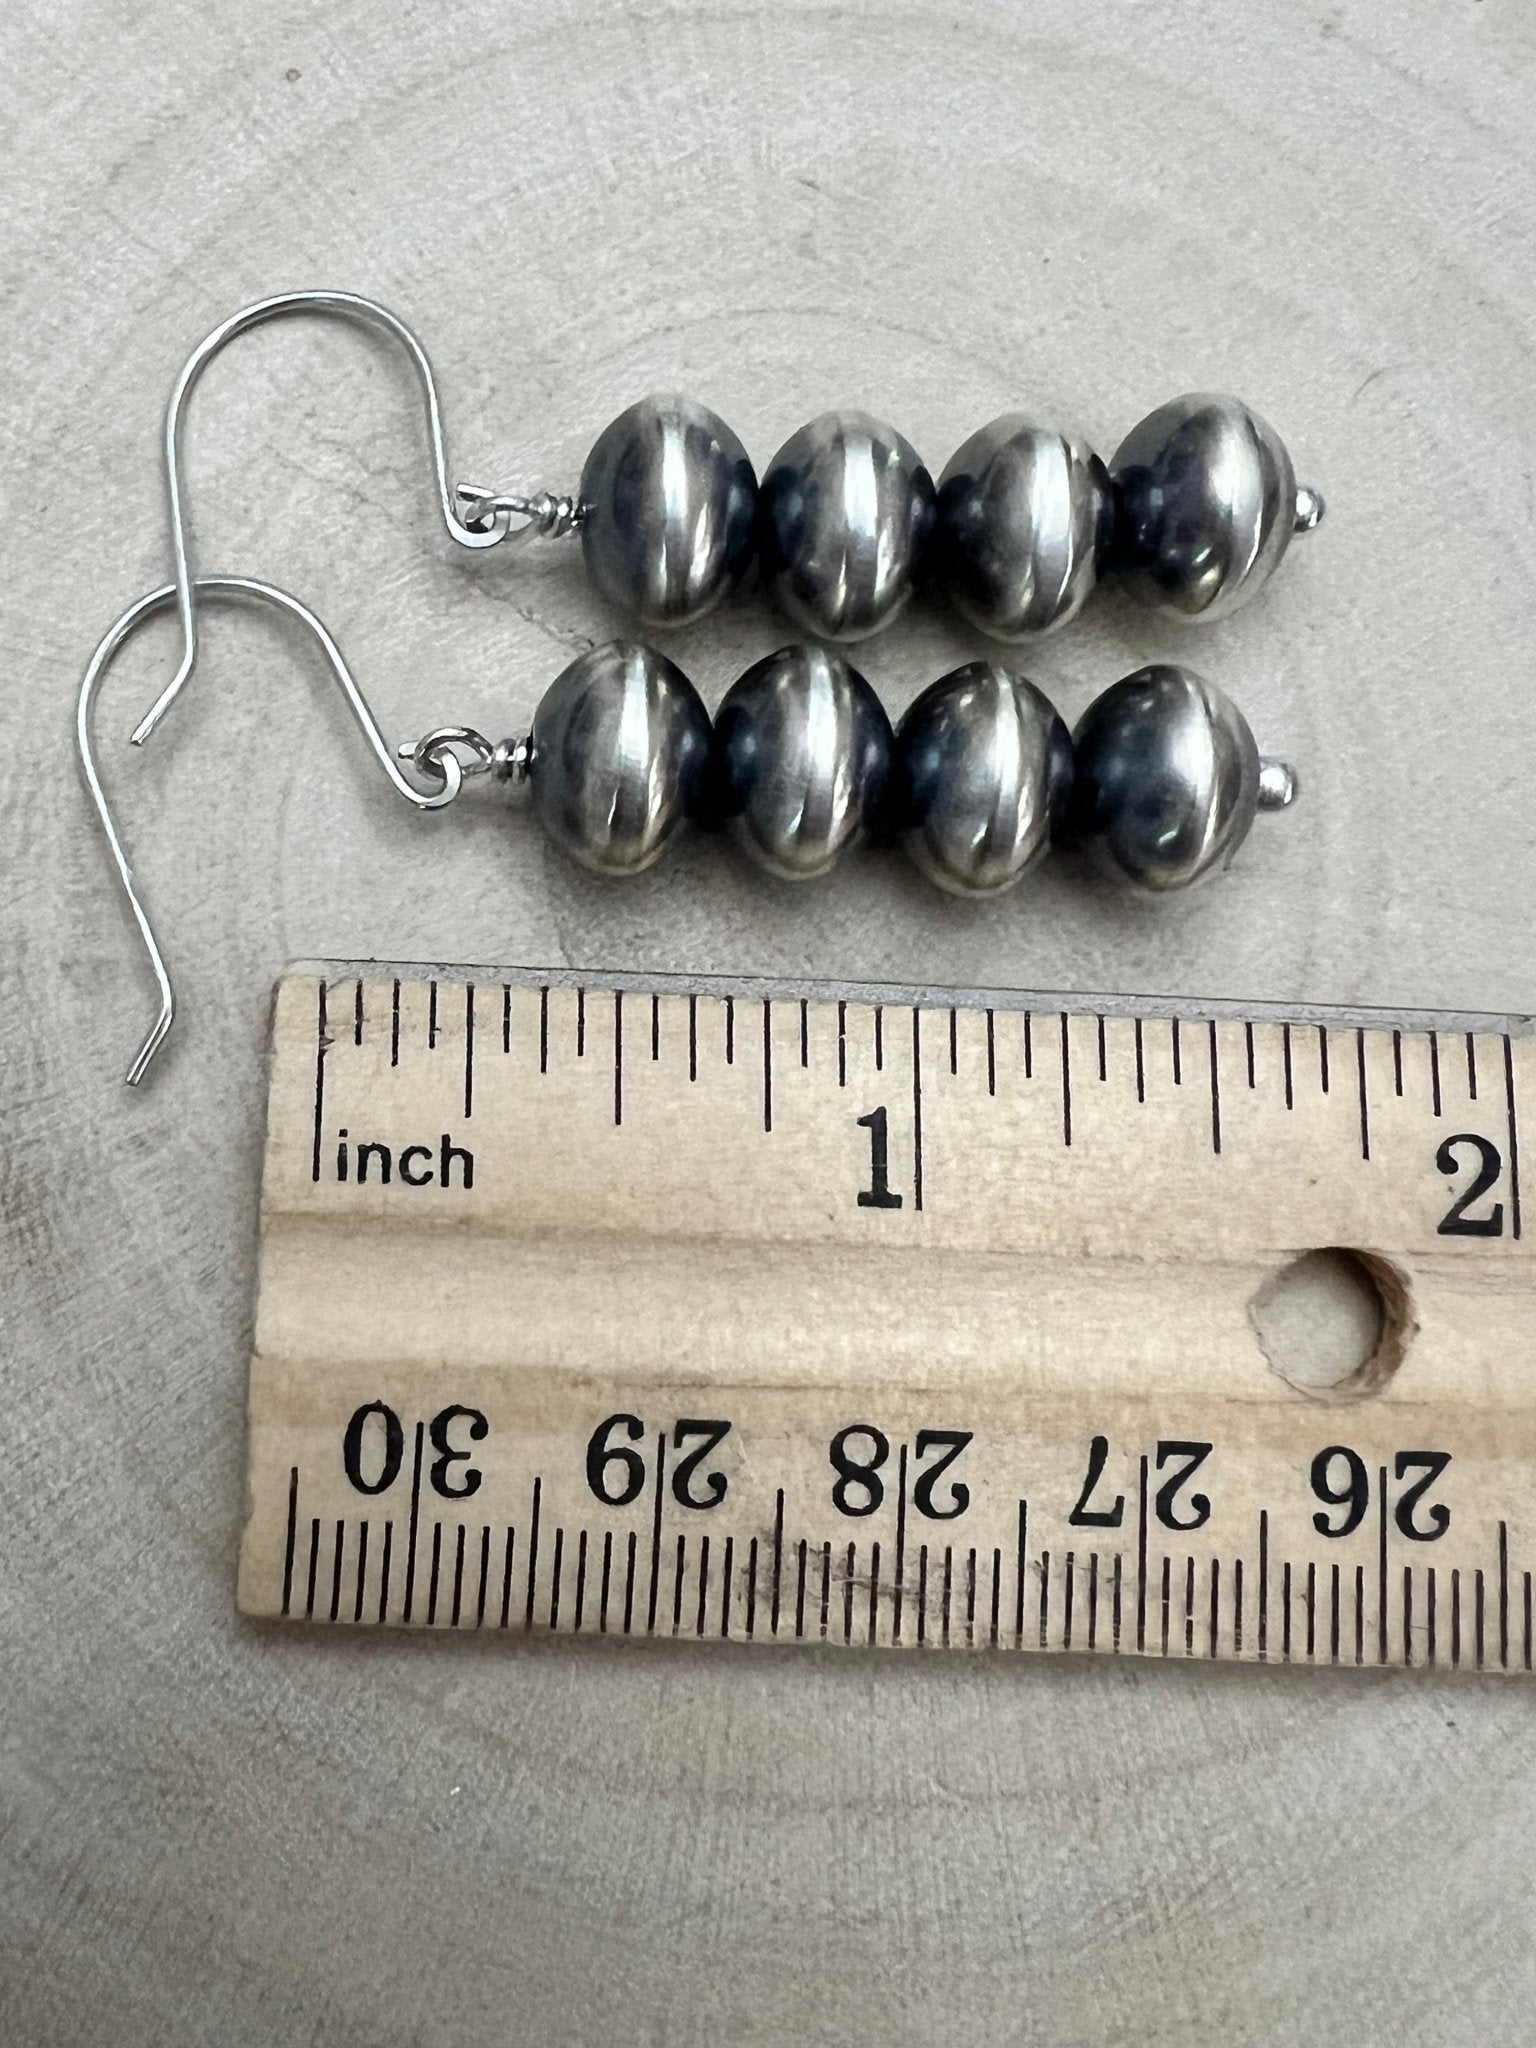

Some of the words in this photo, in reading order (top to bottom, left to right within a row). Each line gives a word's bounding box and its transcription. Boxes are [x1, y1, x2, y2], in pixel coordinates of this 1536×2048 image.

[336, 1129, 474, 1190] inch
[856, 1106, 903, 1209] 1
[1435, 1133, 1504, 1238] 2
[342, 1399, 489, 1499] 30
[585, 1413, 732, 1511] 29
[829, 1424, 974, 1520] 28
[1068, 1435, 1213, 1531] 27
[1310, 1445, 1453, 1542] 26
